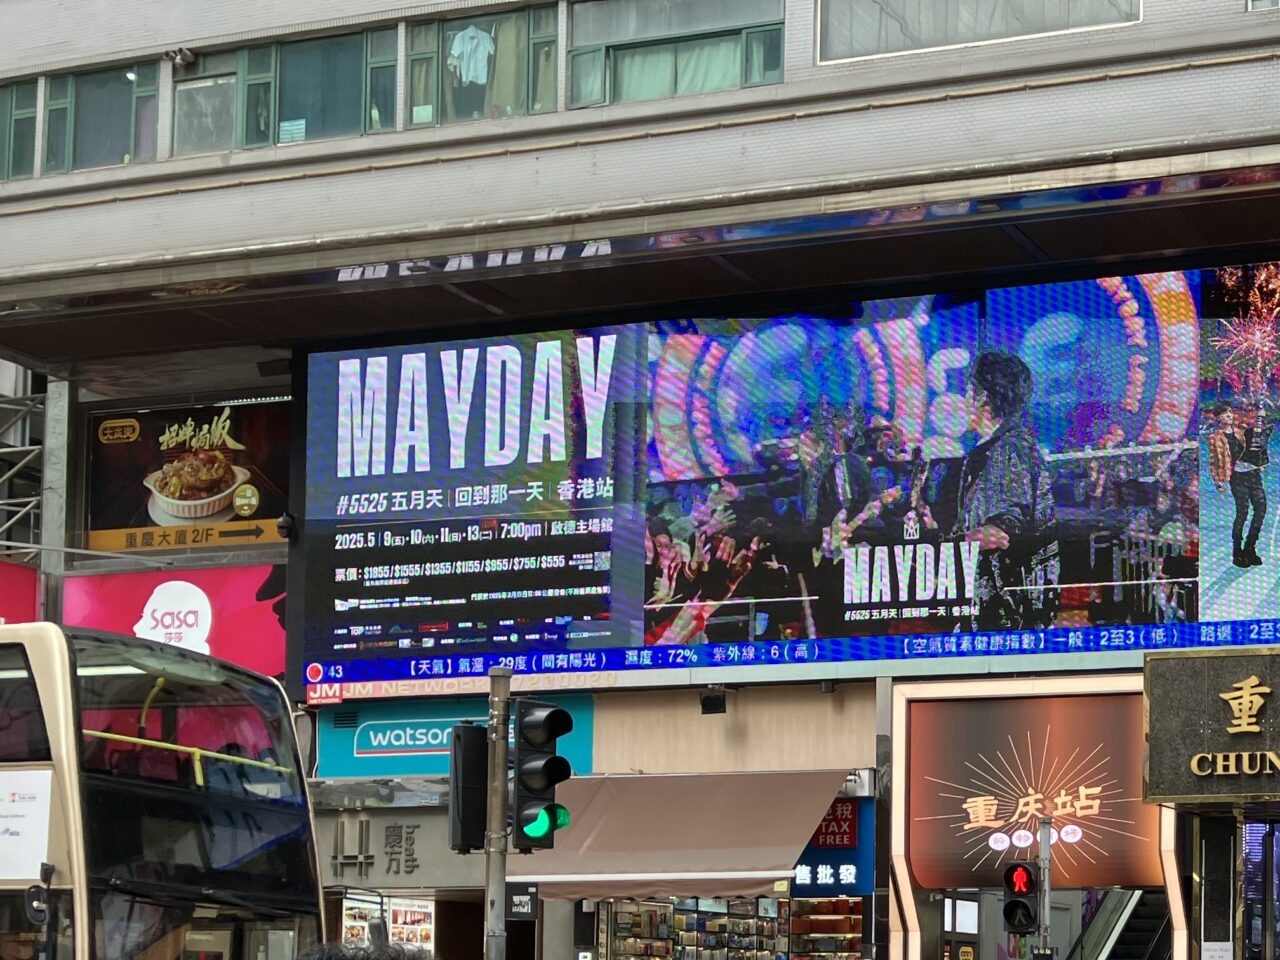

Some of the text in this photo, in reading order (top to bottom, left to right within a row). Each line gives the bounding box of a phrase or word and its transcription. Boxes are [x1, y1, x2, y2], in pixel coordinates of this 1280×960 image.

[337, 334, 617, 478] MAYDAY
[336, 477, 614, 515] #5525 五月天 回到那一天 香港站
[124, 528, 215, 548] 重慶大廈 2/F
[335, 531, 375, 549] 2025.5
[500, 522, 541, 541] 7:00pm
[843, 541, 981, 604] MAYDAY
[871, 608, 897, 620] 五月天
[309, 684, 340, 698] JM
[344, 683, 373, 697] JM
[381, 678, 491, 695] NETWORK
[821, 821, 850, 833] TAX
[819, 834, 850, 845] FREE
[795, 864, 857, 885] 售批發
